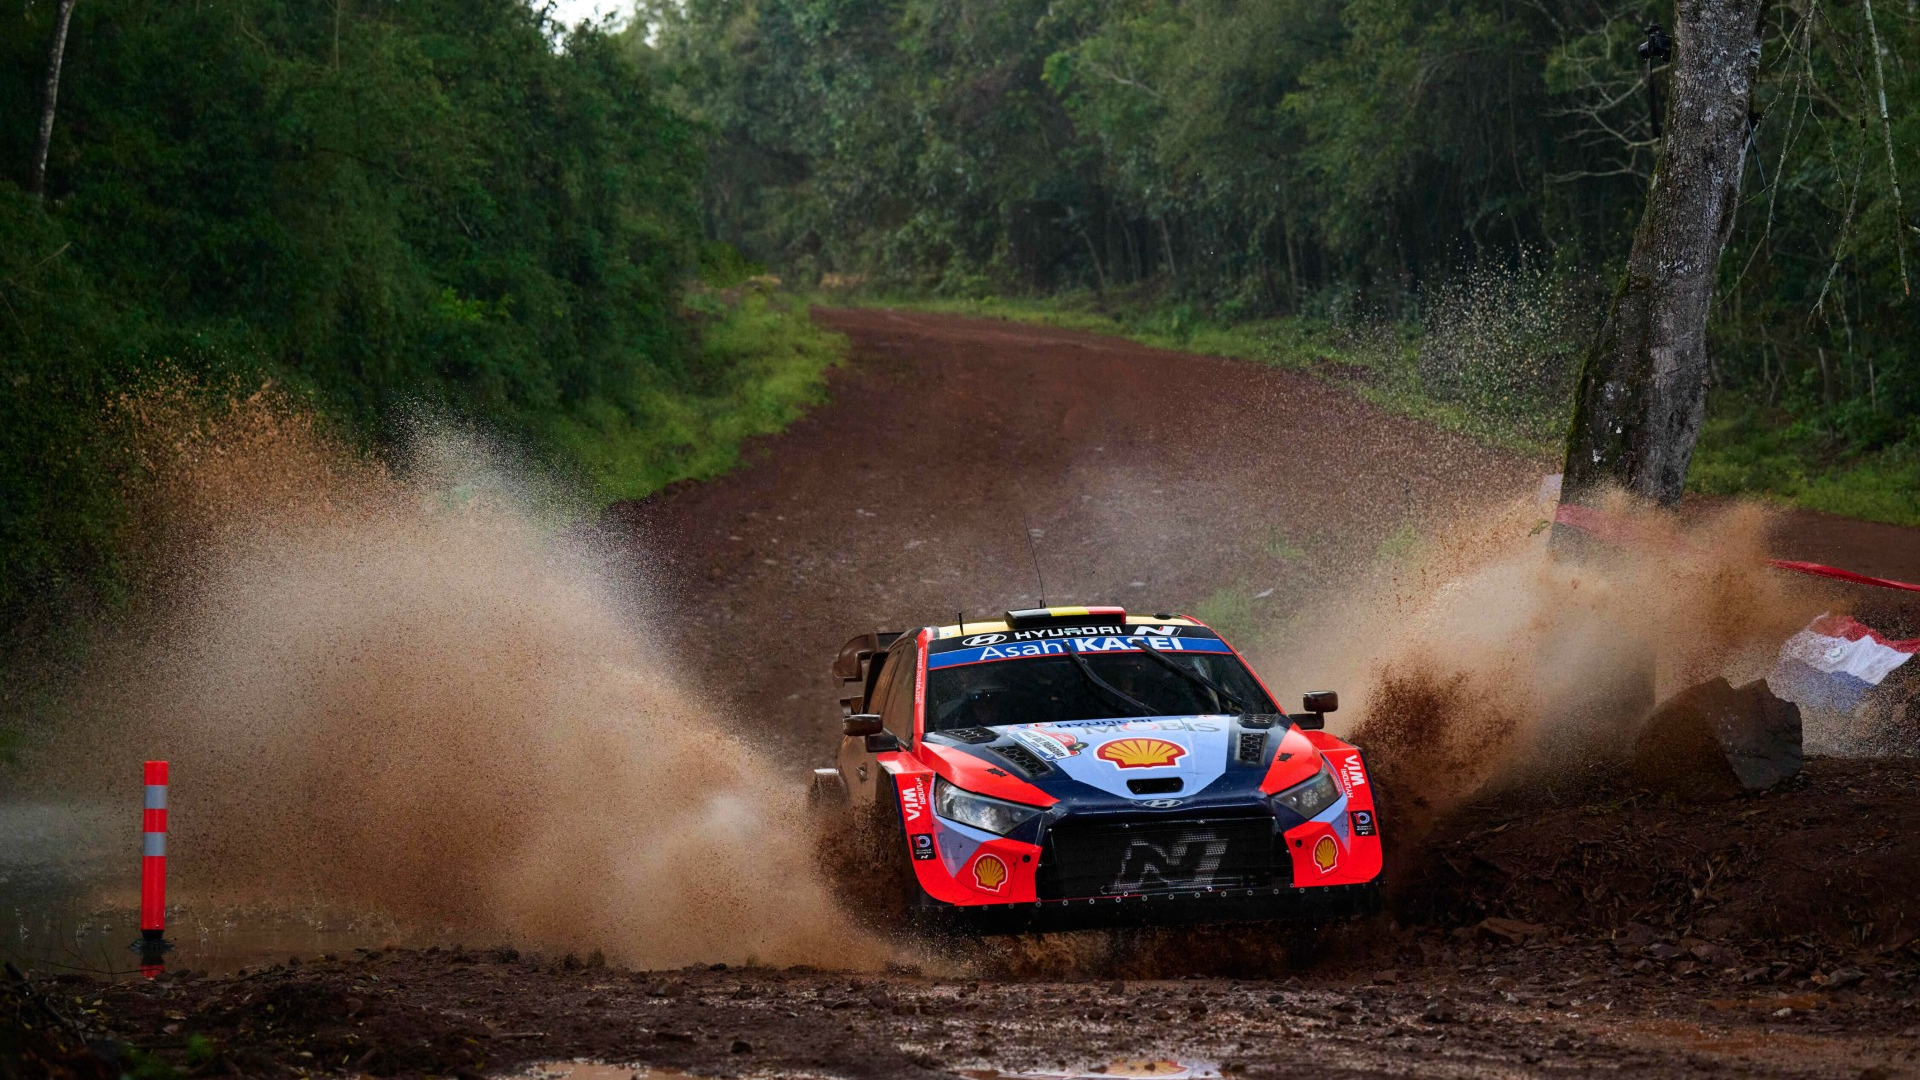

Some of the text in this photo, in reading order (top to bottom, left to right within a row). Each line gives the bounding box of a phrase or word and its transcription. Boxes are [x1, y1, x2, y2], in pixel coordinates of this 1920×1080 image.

[1014, 626, 1123, 640] HYUNDAI
[1074, 637, 1184, 651] KASEI
[1082, 722, 1221, 735] MOBIS
[1341, 768, 1354, 798] HYUNDAI
[915, 777, 926, 805] HYUNDAI
